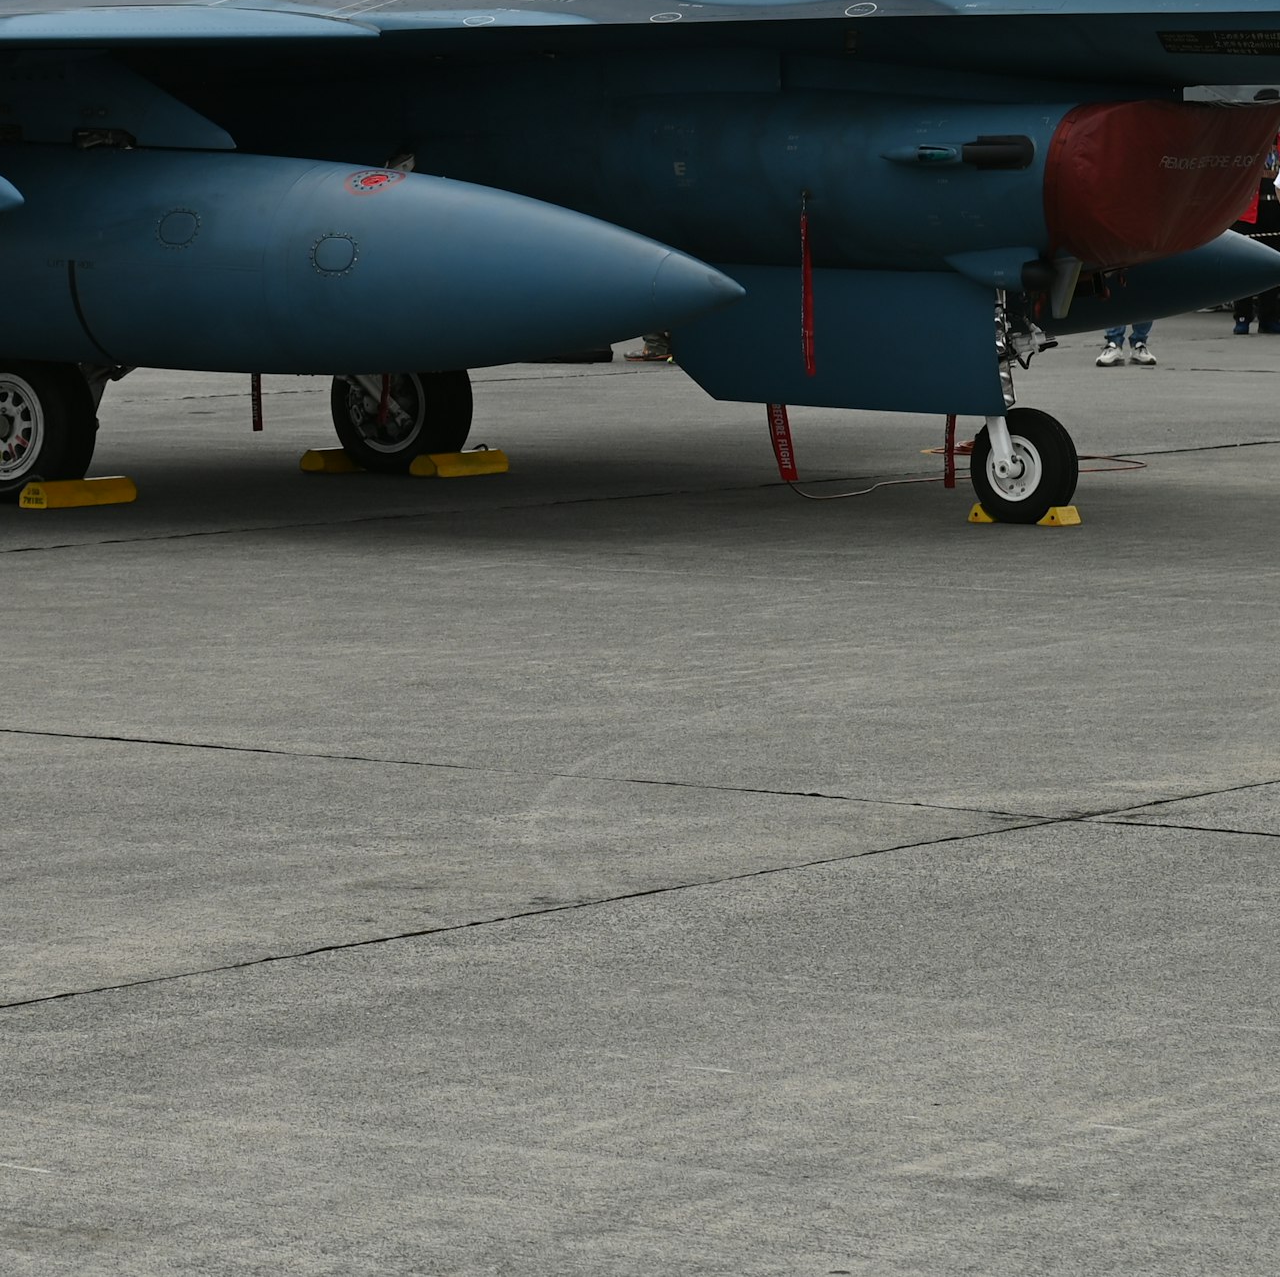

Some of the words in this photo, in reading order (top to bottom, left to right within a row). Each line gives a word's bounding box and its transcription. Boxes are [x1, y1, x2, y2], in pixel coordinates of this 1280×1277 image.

[673, 161, 687, 176] E
[1159, 155, 1198, 170] REMOVE
[1197, 154, 1231, 169] BEFORE
[771, 402, 786, 436] BEFORE
[777, 438, 793, 470] FLIGHT
